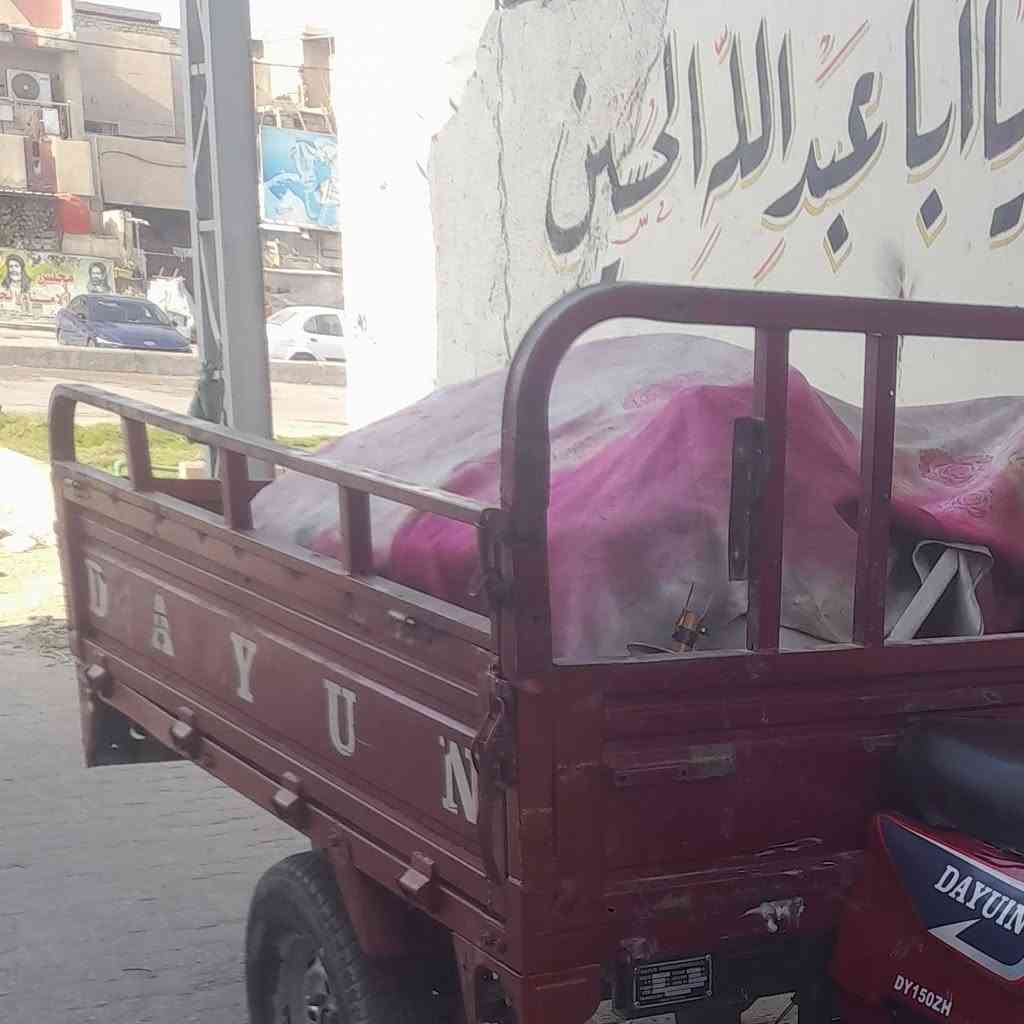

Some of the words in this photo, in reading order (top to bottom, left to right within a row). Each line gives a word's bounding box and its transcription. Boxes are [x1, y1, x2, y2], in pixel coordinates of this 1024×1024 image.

[701, 18, 797, 232] الله
[762, 71, 885, 260] عبد
[86, 559, 479, 824] DAYUN
[894, 974, 953, 1016] DY150ZH
